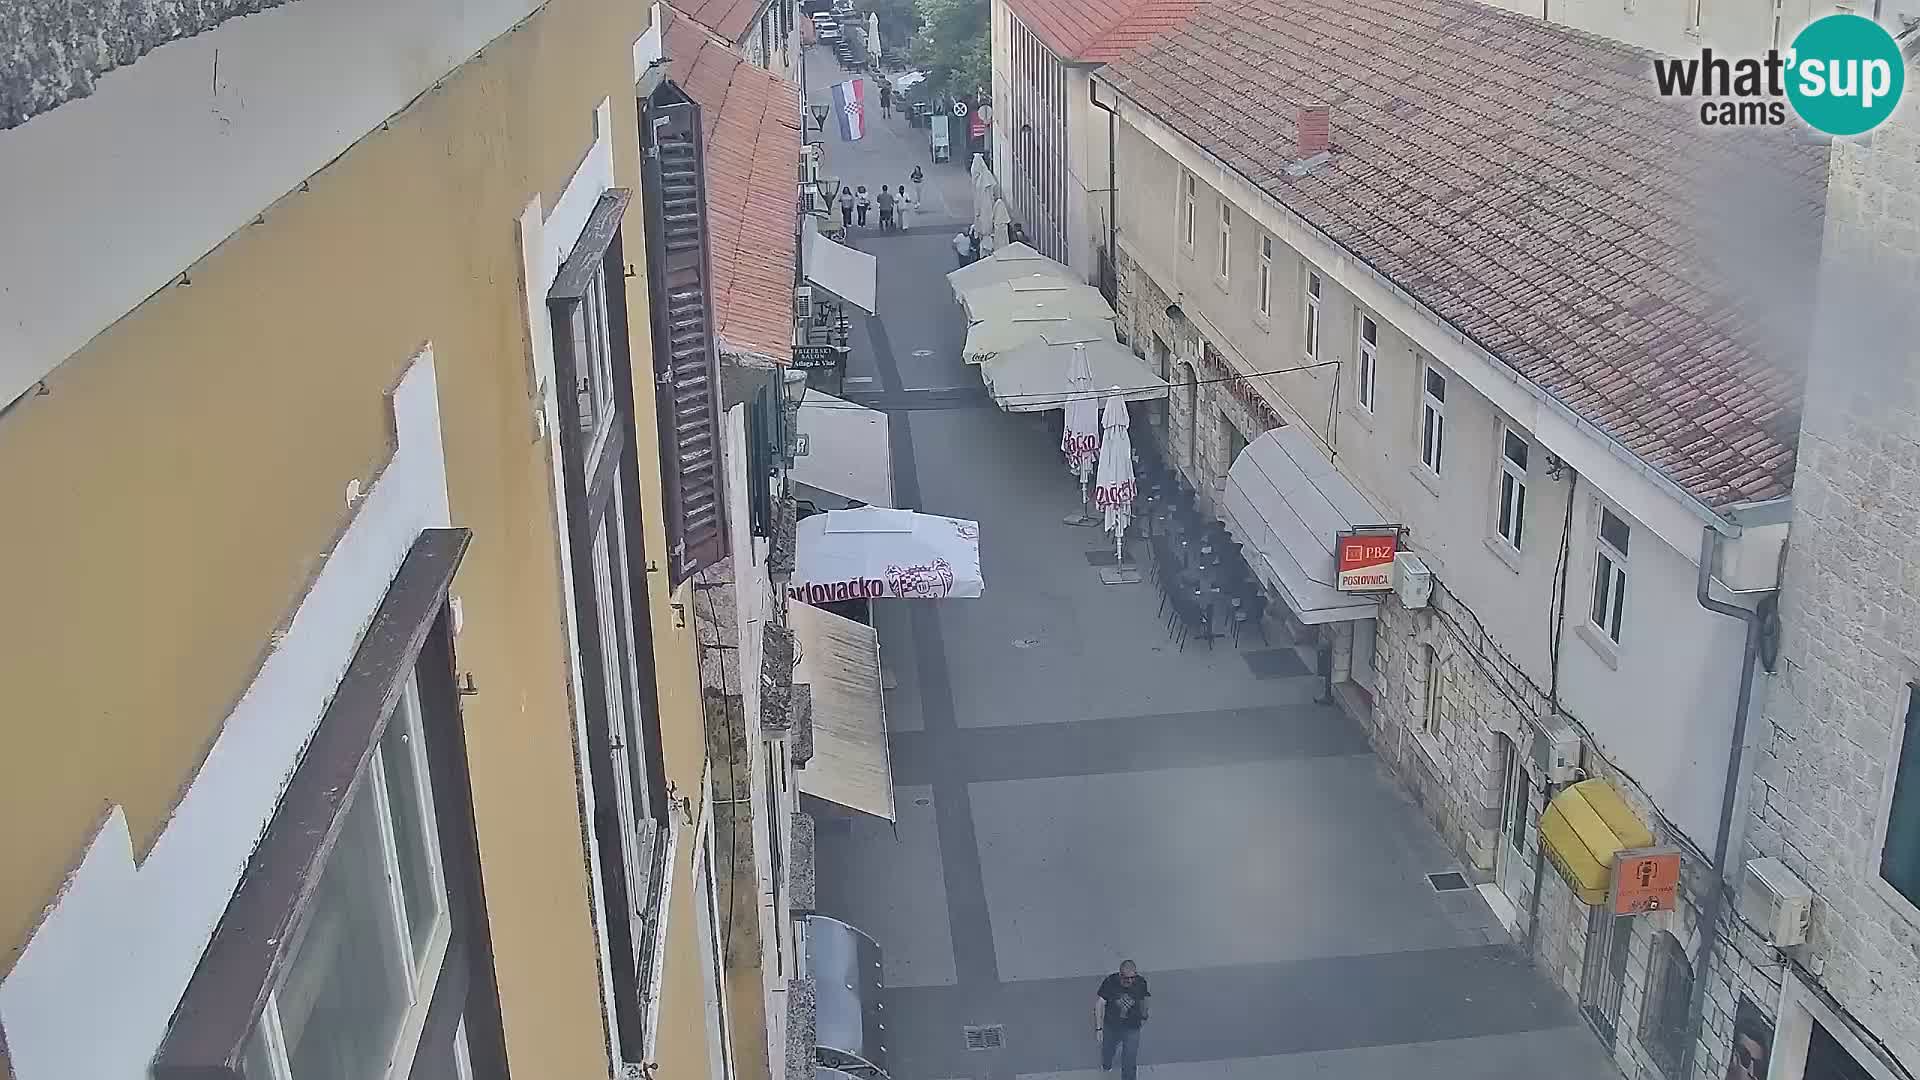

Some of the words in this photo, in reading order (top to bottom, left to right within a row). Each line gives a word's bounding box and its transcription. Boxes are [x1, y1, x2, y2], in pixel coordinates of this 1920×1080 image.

[1366, 546, 1391, 559] PBZ
[1342, 574, 1389, 586] POSLOVNICA
[788, 576, 884, 604] arlovačko
